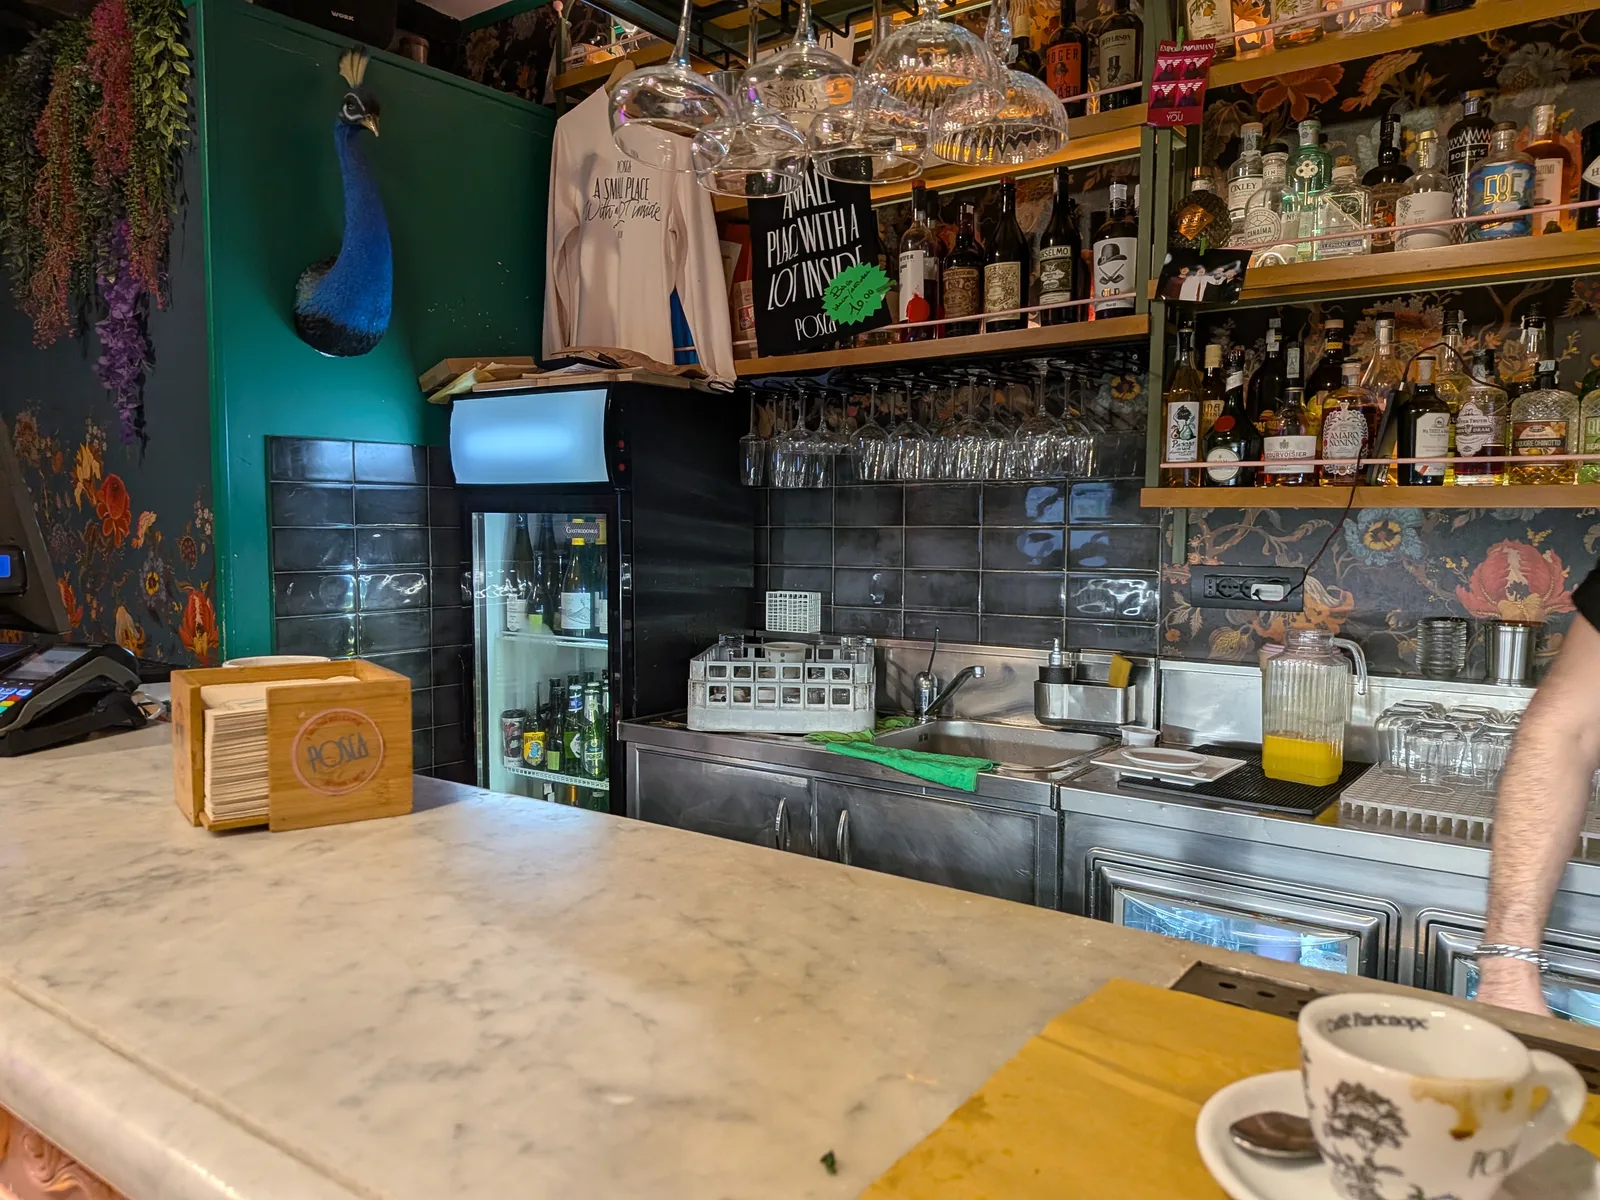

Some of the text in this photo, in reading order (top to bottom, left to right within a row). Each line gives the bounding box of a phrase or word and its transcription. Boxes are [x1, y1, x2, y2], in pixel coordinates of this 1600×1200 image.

[331, 10, 355, 21] WORK
[1166, 113, 1184, 122] YOU
[1451, 148, 1486, 161] BOBBY'S
[1264, 169, 1276, 177] GIN
[592, 177, 601, 199] A
[625, 176, 651, 201] PLACE
[1230, 182, 1257, 193] OXLEY
[797, 208, 848, 254] WITH
[850, 203, 860, 242] A
[767, 262, 799, 311] LOT
[1330, 431, 1360, 440] AMARO
[1329, 439, 1360, 447] NONINO
[1266, 451, 1307, 459] COURVOISIER
